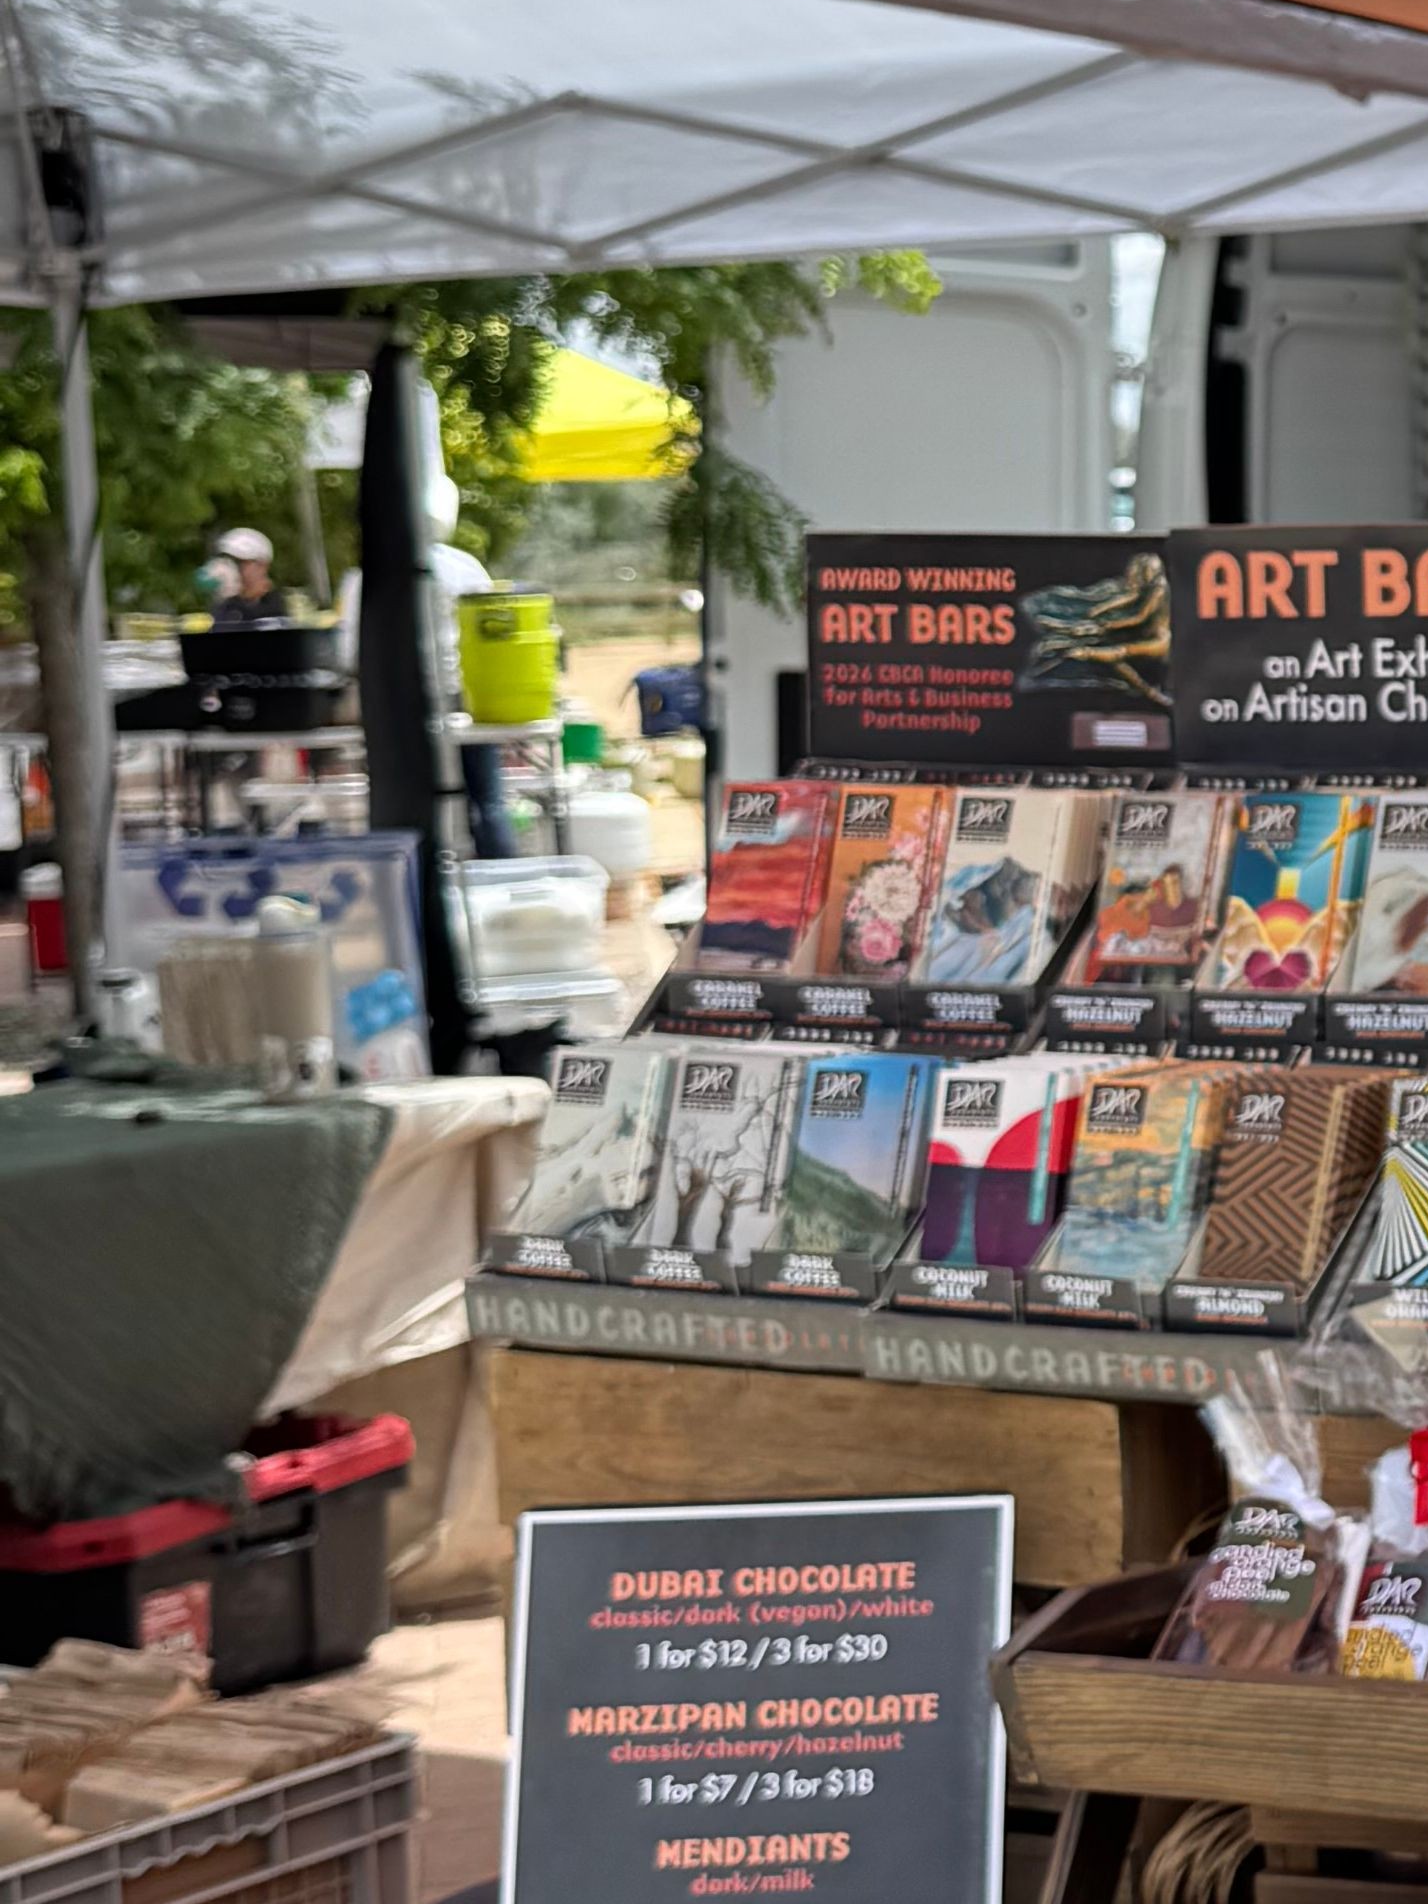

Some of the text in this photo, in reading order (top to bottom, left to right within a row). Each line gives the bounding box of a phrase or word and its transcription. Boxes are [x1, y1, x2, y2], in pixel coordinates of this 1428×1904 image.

[820, 567, 1016, 592] AWARD WINNING
[1196, 549, 1339, 619] ART
[820, 603, 1016, 645] ART BARS
[928, 666, 1015, 686] Honoree
[1263, 656, 1300, 679] an
[1304, 637, 1363, 679] Art
[823, 689, 857, 708] for
[860, 690, 902, 709] Arts
[925, 688, 1014, 710] Business
[1202, 699, 1239, 722] on
[1242, 681, 1368, 723] Artisan
[861, 711, 981, 735] Partnership
[478, 1299, 788, 1353] HANDCRAFTED
[876, 1334, 1208, 1394] HANDCRAFTED
[611, 1562, 917, 1601] DUBAI CHOCOLATE
[588, 1601, 741, 1629] classic/dark
[636, 1643, 651, 1670] 1
[655, 1640, 696, 1669] for
[696, 1638, 748, 1670] $12
[769, 1638, 793, 1667] 3
[796, 1634, 834, 1665] for
[834, 1632, 888, 1664] $30
[567, 1692, 940, 1737] MARZIPAN CHOCOLATE
[637, 1777, 653, 1806] 1
[656, 1774, 698, 1805] for
[698, 1772, 738, 1806] $7
[759, 1771, 781, 1802] 3
[782, 1769, 822, 1801] for
[822, 1767, 875, 1798] $18
[655, 1832, 851, 1869] MENDIANTS
[689, 1868, 815, 1896] dark/milk
